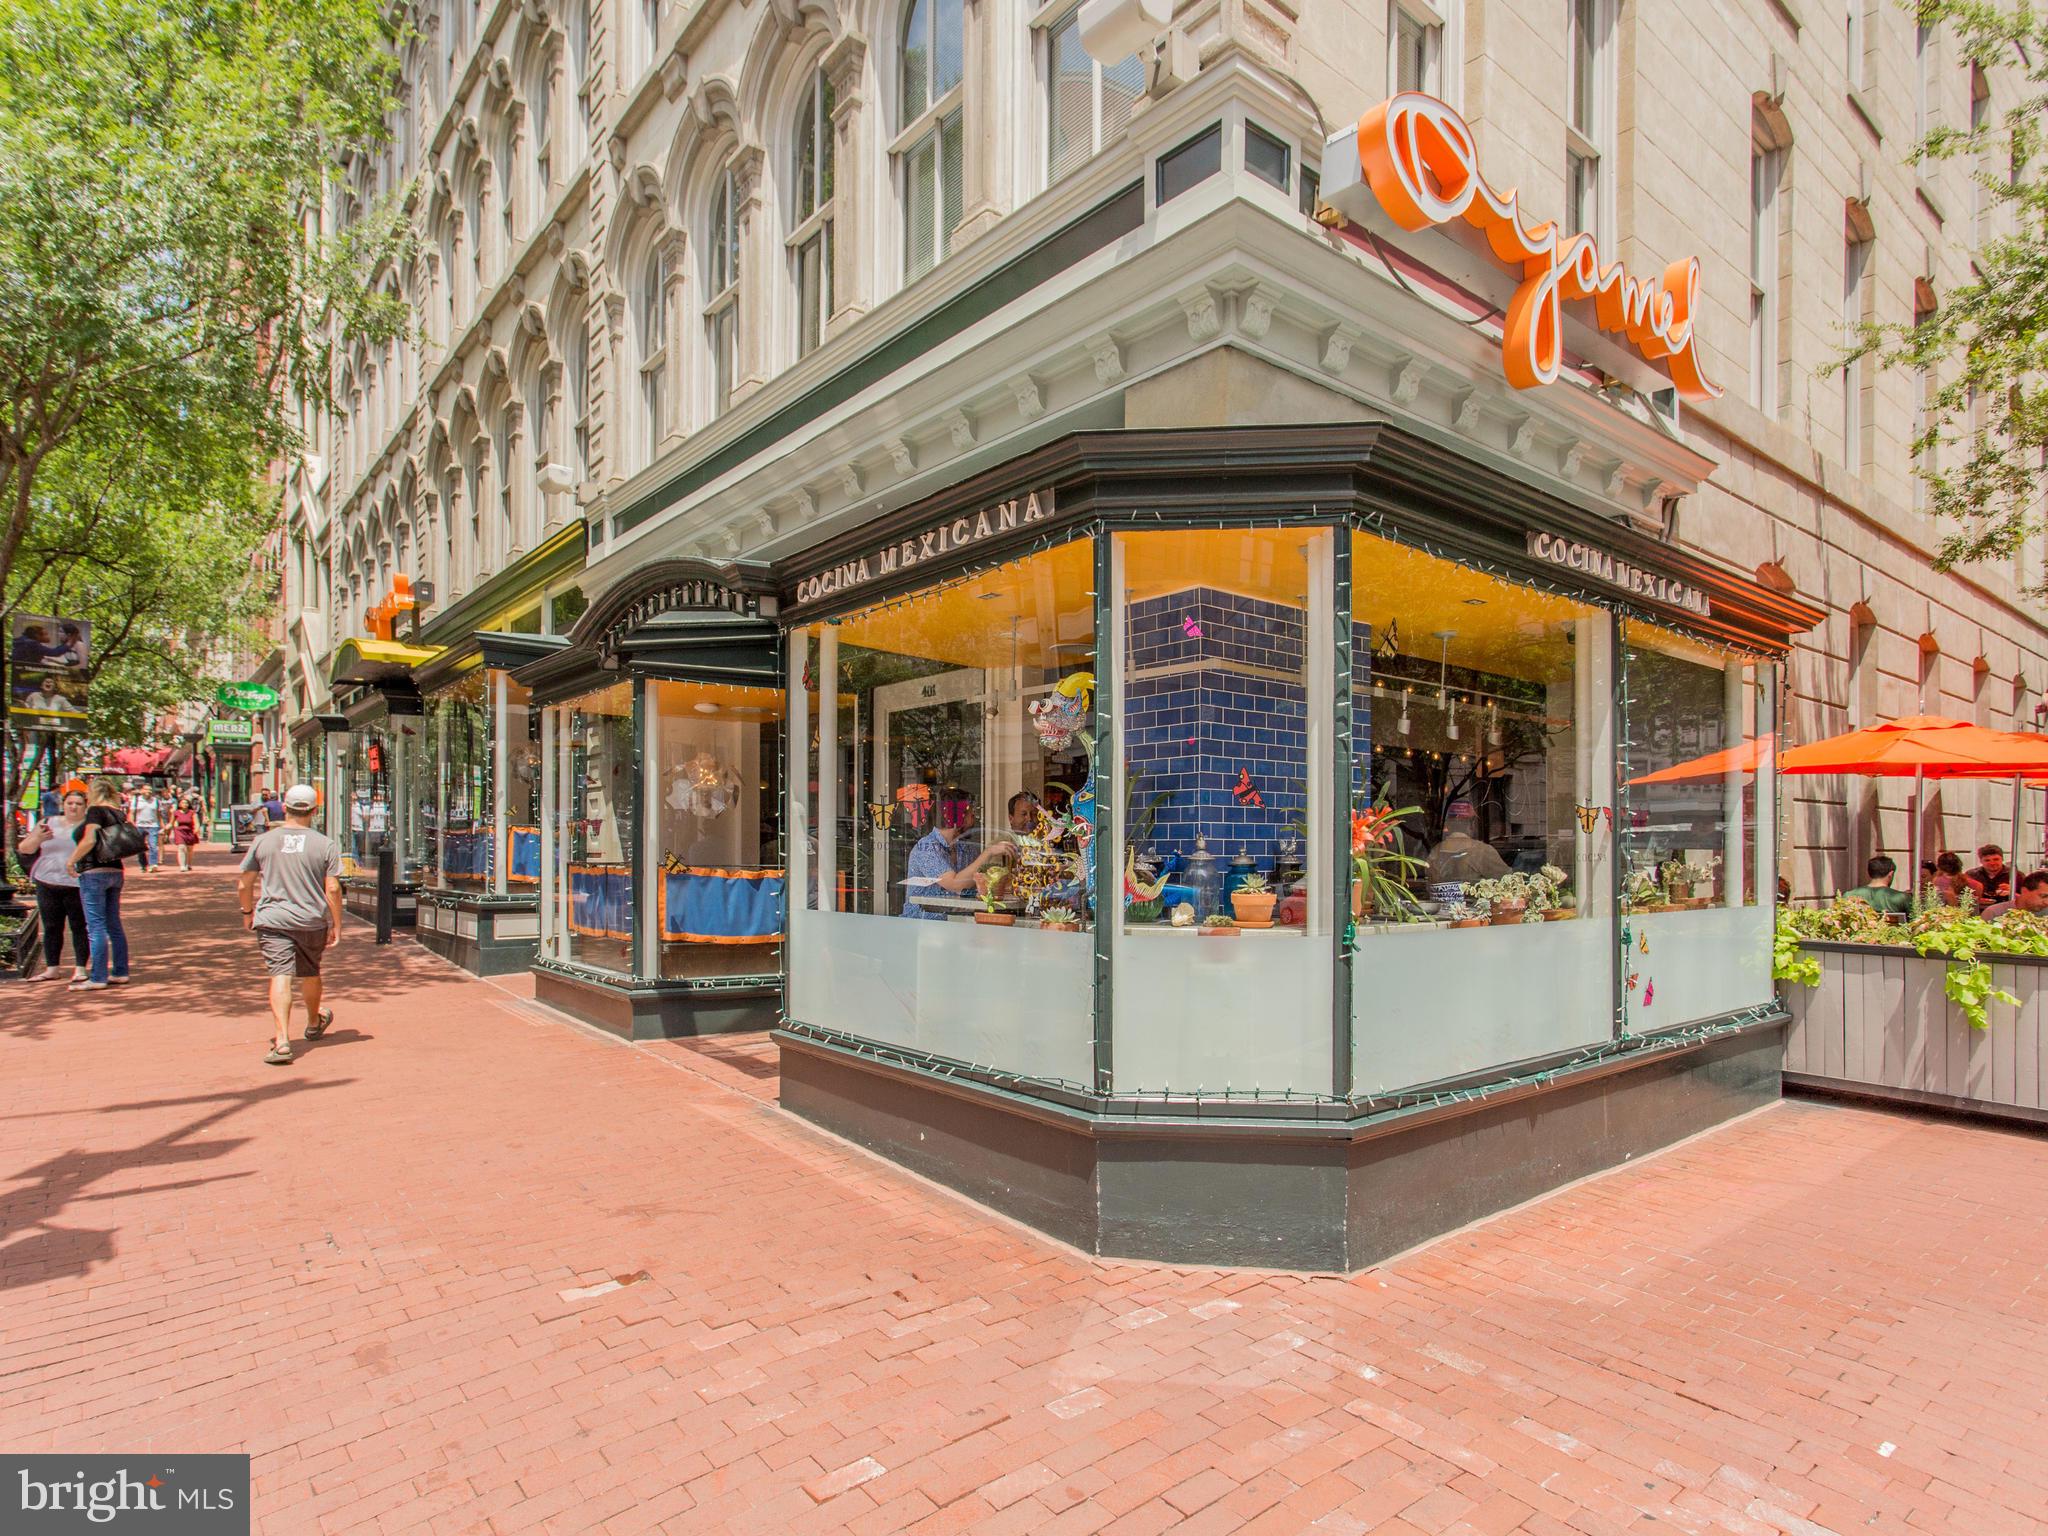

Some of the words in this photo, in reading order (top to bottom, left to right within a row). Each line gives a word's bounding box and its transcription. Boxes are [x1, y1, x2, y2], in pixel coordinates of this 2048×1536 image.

[1359, 91, 1724, 400] Oyamel
[797, 558, 871, 603] COCINA
[880, 492, 1045, 575] MEXICANA
[1534, 533, 1614, 580] COCINA
[1616, 562, 1711, 616] MEXICANA
